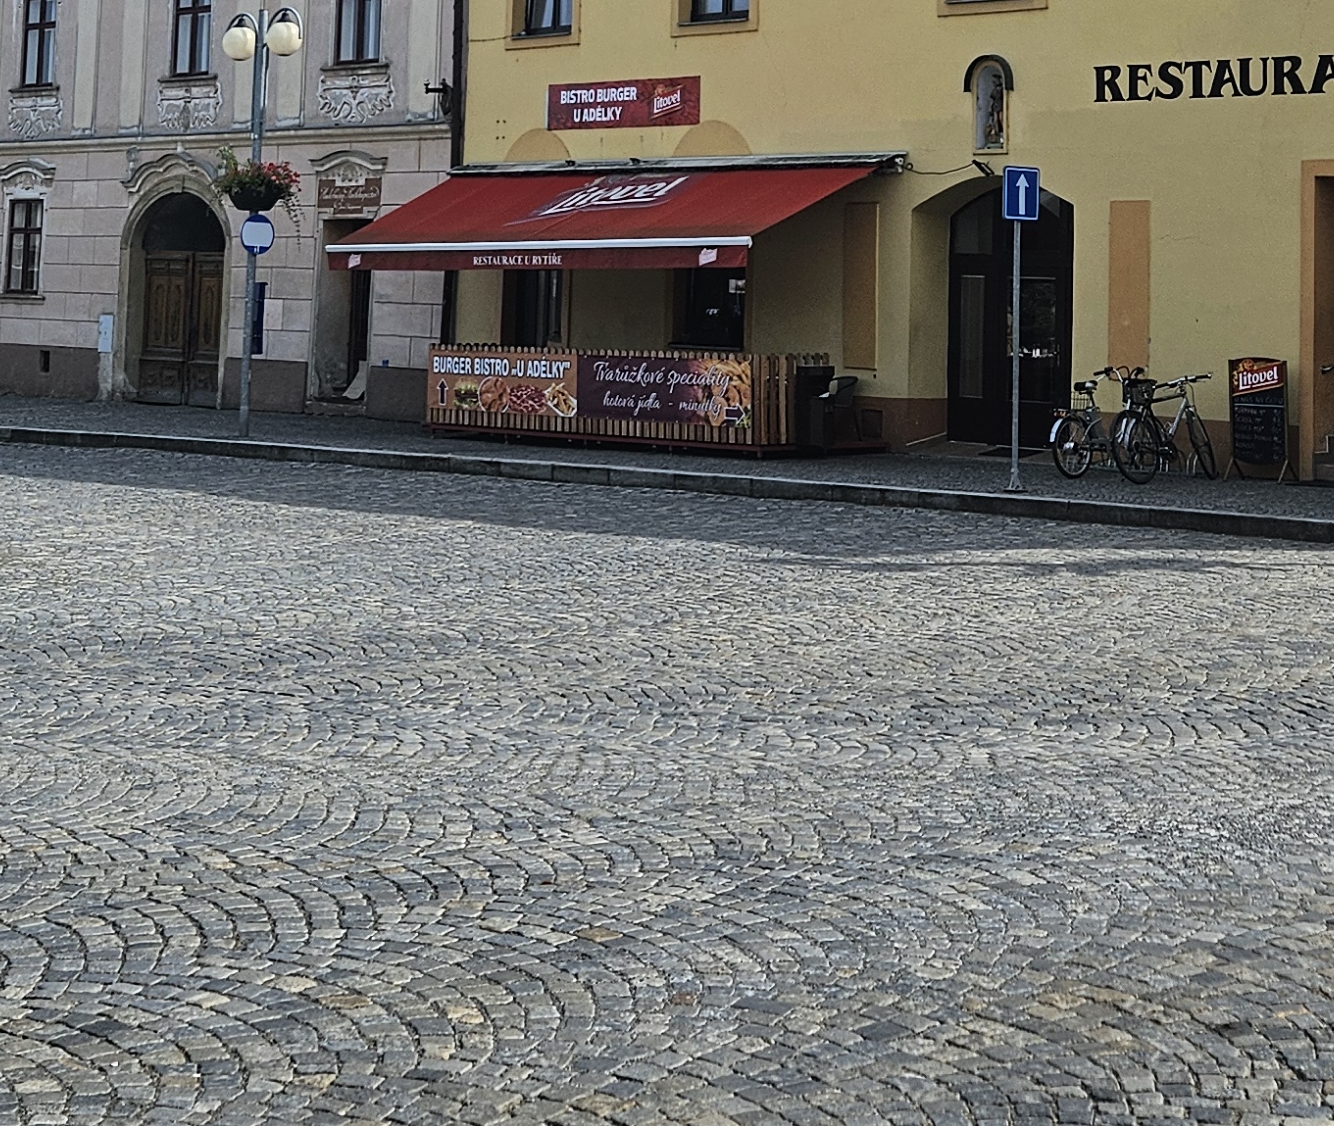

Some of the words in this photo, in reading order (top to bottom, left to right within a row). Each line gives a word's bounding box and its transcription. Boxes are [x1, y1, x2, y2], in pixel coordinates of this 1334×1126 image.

[560, 89, 595, 104] BISTRO
[596, 87, 637, 103] BURGER
[653, 89, 681, 113] Litovel
[573, 109, 581, 122] U
[582, 105, 622, 122] ADÉLKY
[537, 175, 690, 216] Litvel
[473, 255, 523, 265] RESTAURACE
[524, 255, 531, 265] U
[532, 253, 562, 265] RYTÍŘE
[433, 356, 472, 374] BURGER
[474, 358, 509, 376] BISTRO
[593, 359, 665, 387] Tvarůžkové
[667, 364, 731, 397] speciality
[1238, 366, 1279, 391] Litovel
[603, 390, 635, 408] hotová
[633, 392, 661, 416] jídla
[678, 397, 722, 420] minutky
